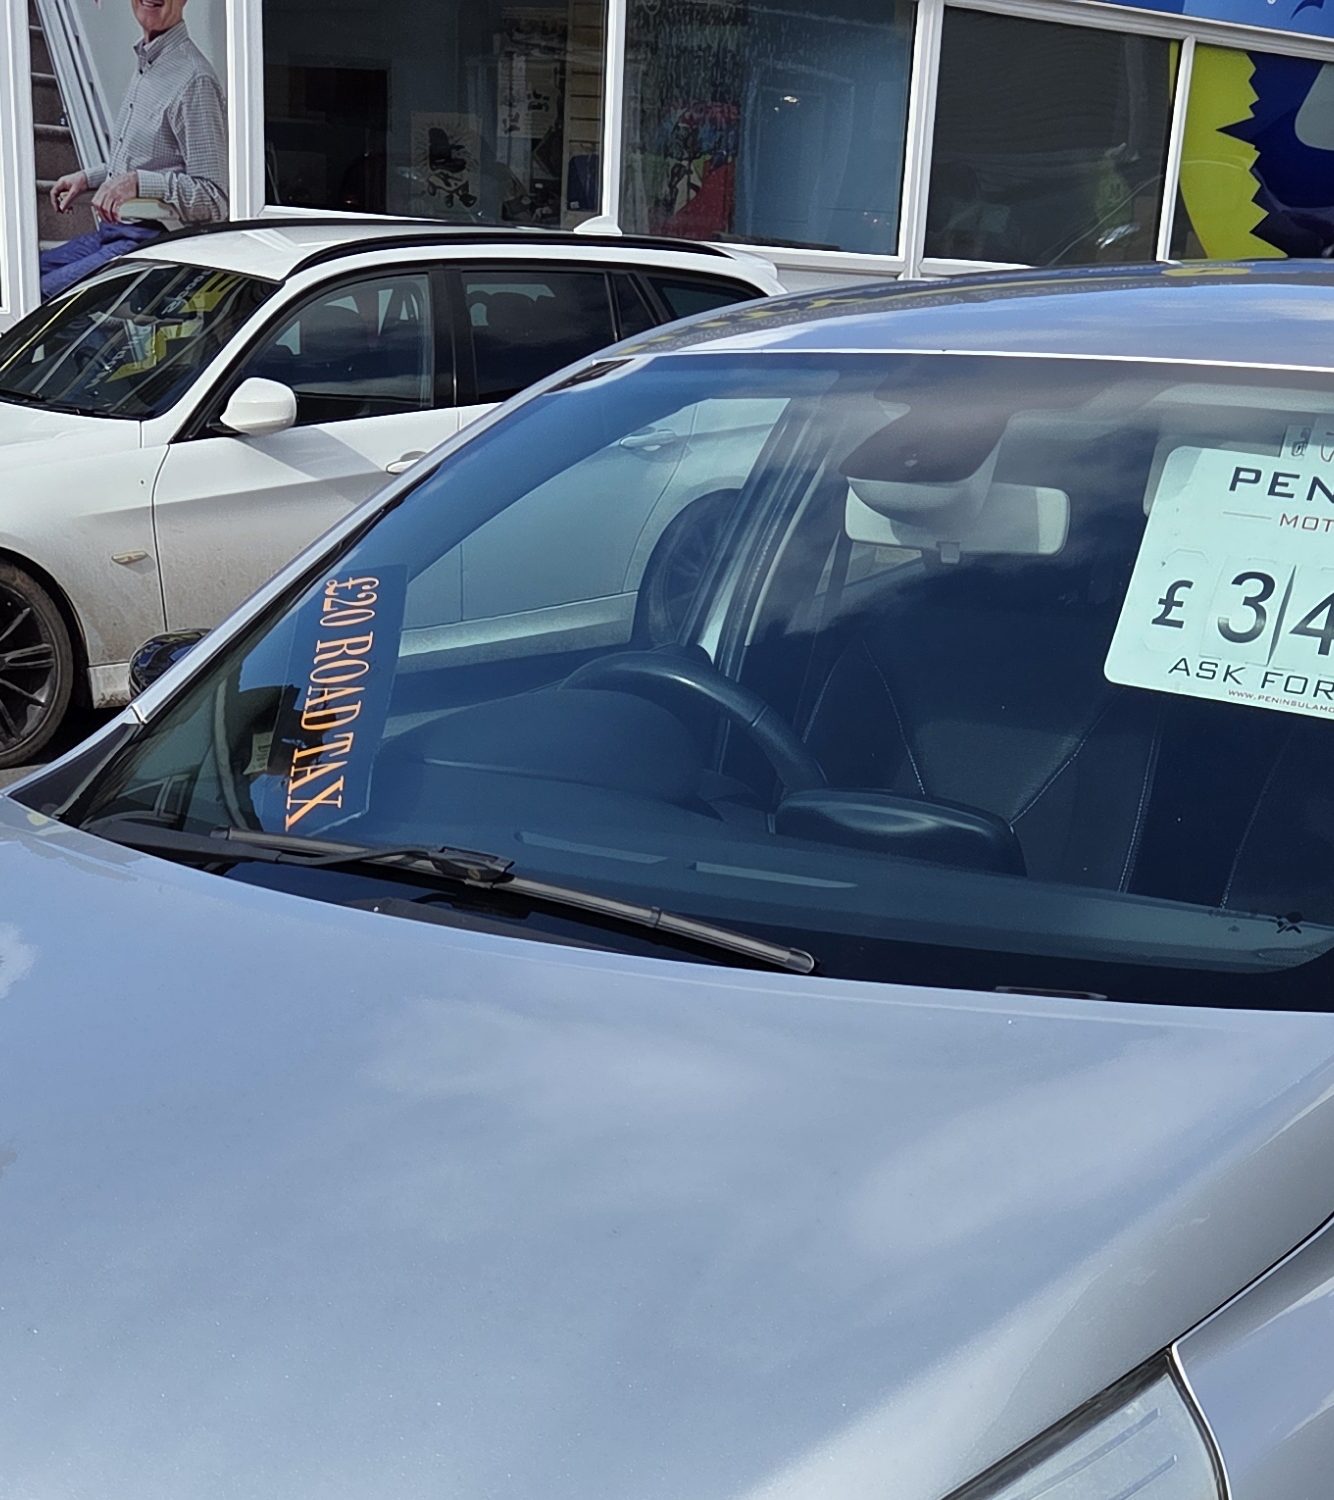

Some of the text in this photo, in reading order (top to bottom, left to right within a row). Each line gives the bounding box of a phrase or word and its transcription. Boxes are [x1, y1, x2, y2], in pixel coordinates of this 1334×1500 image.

[284, 576, 380, 832] £20 ROAD TAX
[1168, 657, 1247, 686] ASK
